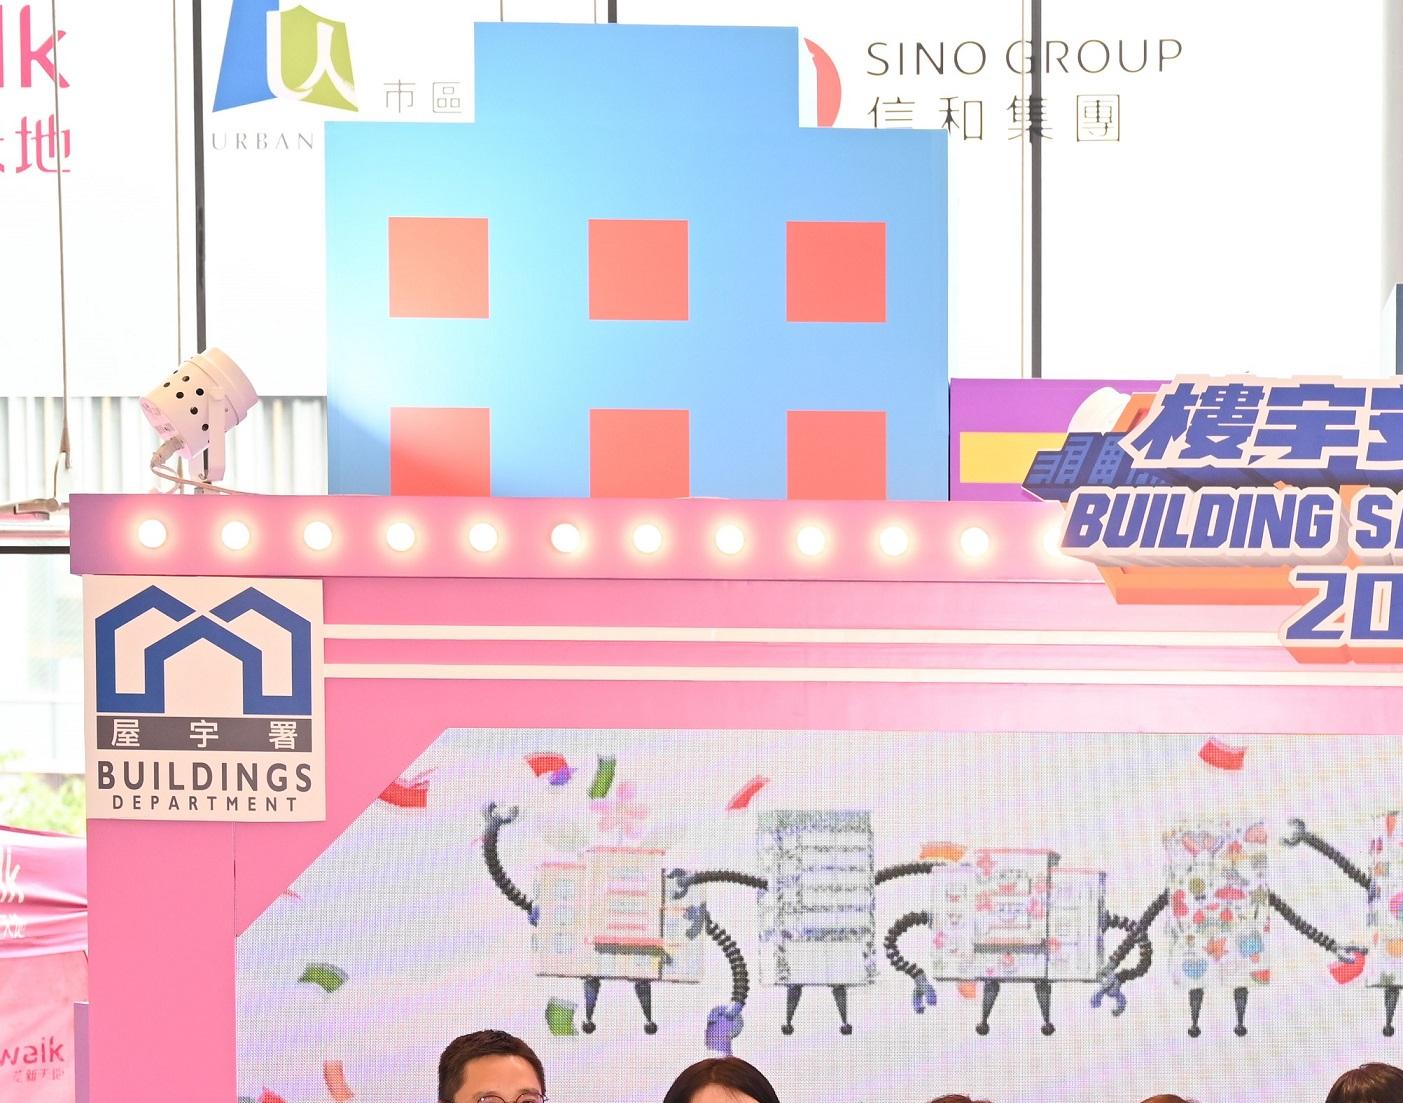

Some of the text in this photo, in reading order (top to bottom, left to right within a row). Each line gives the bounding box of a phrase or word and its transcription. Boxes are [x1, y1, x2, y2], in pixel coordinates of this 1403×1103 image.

[866, 39, 1183, 76] SINO GROUP
[383, 80, 463, 114] 市區
[867, 94, 1121, 143] 信和集團
[211, 132, 314, 151] URBAN
[1069, 491, 1337, 551] BUILDING
[111, 718, 298, 750] 屋宇署
[97, 760, 312, 792] BUILDINGS
[112, 795, 297, 812] DEPARTMENT
